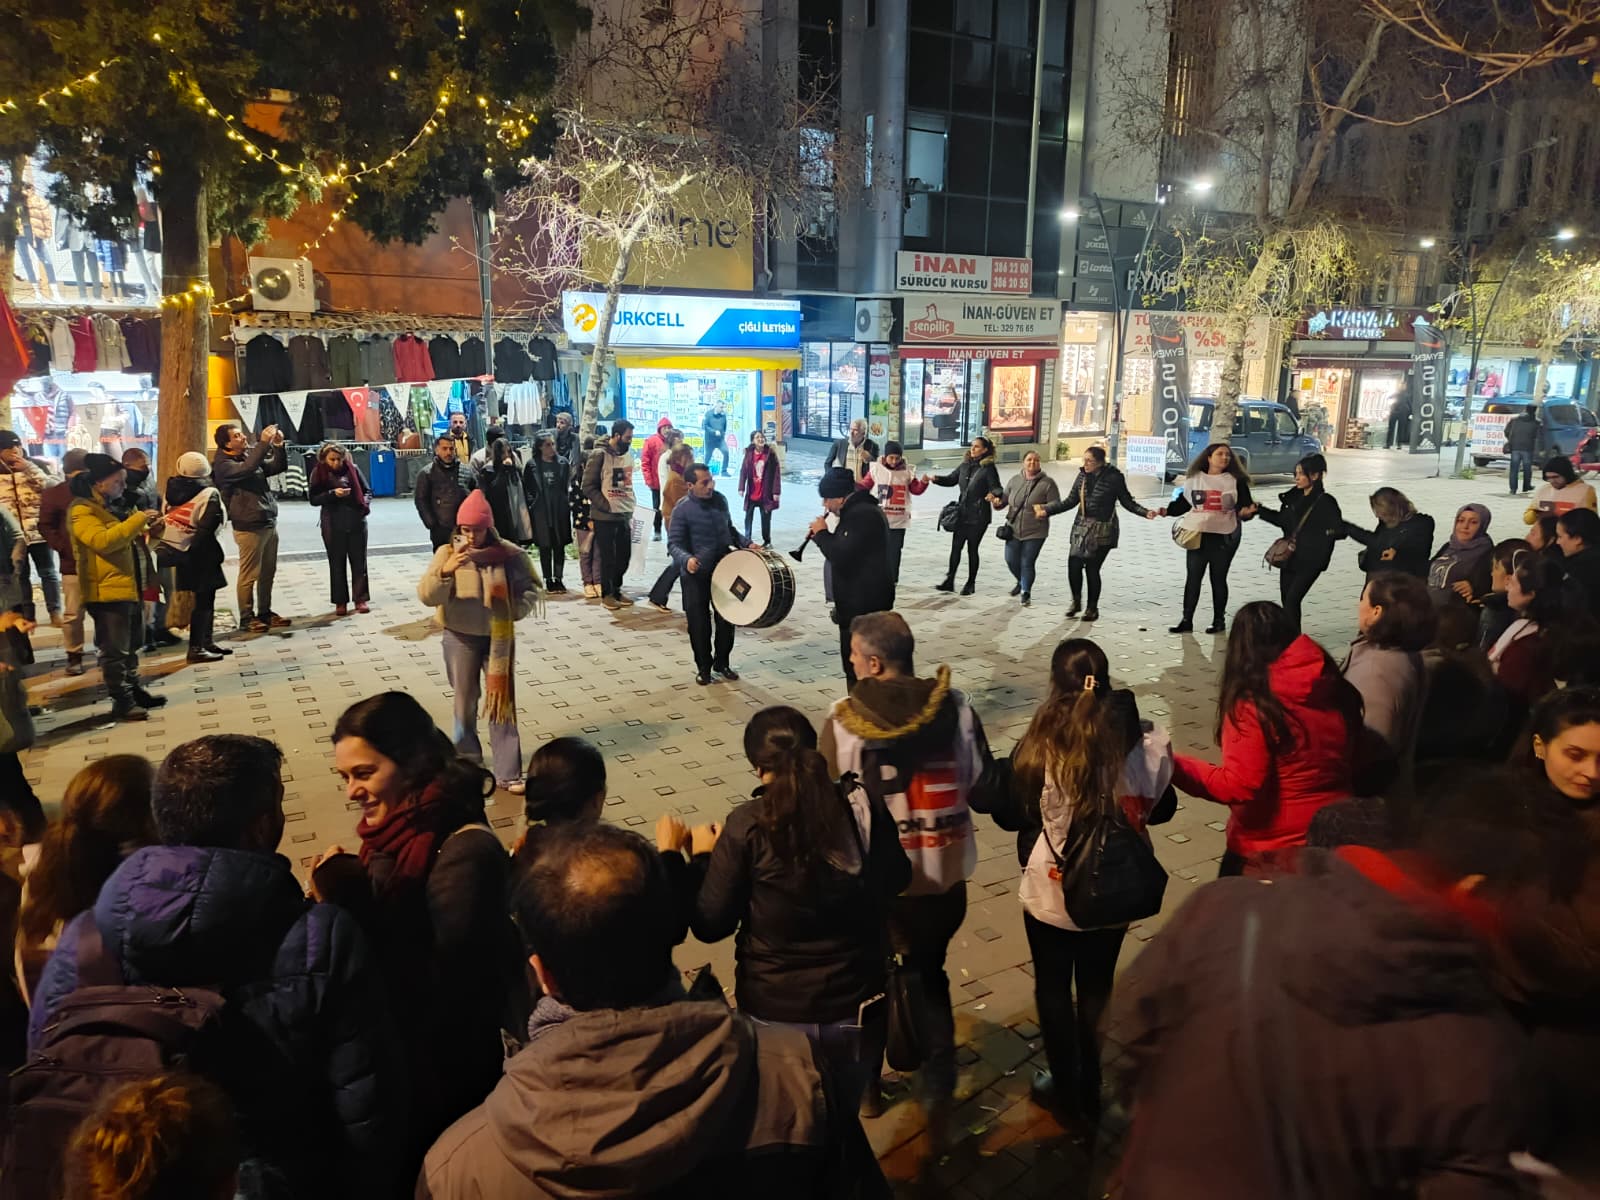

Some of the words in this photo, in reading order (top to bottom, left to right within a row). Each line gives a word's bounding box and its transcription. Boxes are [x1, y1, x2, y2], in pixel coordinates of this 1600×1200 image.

[994, 261, 1008, 273] 386
[1009, 262, 1018, 273] 22
[1019, 262, 1029, 274] 00
[900, 273, 947, 288] SÜRÜCÜ
[951, 278, 988, 289] KURSU
[993, 276, 1007, 288] 386
[1009, 277, 1018, 288] 20
[1019, 278, 1028, 289] 55
[611, 310, 685, 327] URKCELL
[962, 302, 1037, 320] İNAN-GÜVEN
[1040, 307, 1056, 321] ET
[739, 320, 761, 335] ÇİĞLİ
[762, 321, 796, 335] İLETİŞİM
[914, 320, 951, 335] şenpiliç
[984, 324, 999, 333] TEL:
[1001, 324, 1014, 333] 329
[948, 348, 972, 359] İNAN
[976, 348, 1009, 359] GÜVEN
[1012, 350, 1025, 359] ET
